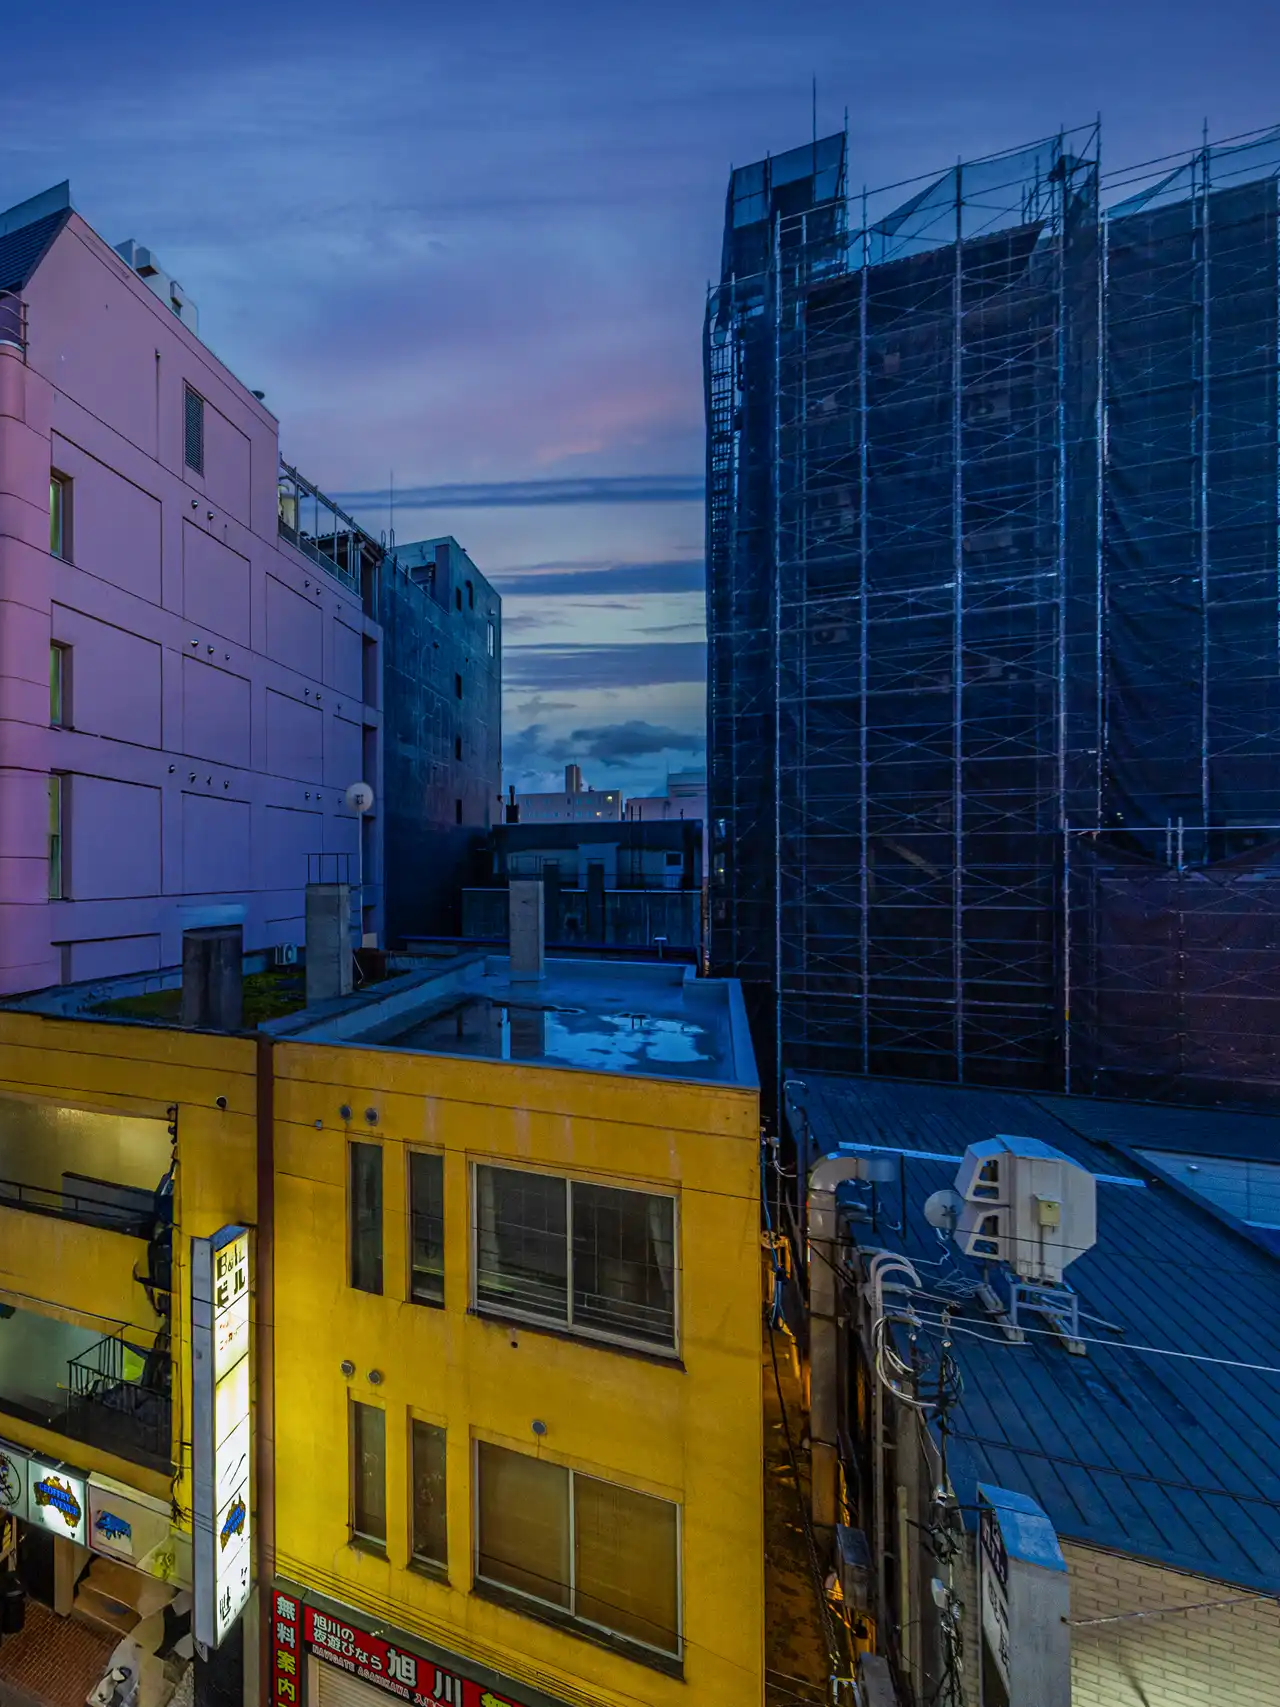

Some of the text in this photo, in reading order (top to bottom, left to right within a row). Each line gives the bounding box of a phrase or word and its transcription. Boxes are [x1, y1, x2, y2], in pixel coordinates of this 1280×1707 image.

[216, 1267, 246, 1309] ビル
[38, 1482, 71, 1502] GEOFFRY
[49, 1496, 78, 1515] AVENUE
[312, 1613, 355, 1642] 旭川の
[276, 1596, 296, 1707] 無料案内
[313, 1628, 383, 1671] 夜遊びなら
[357, 1665, 410, 1698] ASAHIKAWA
